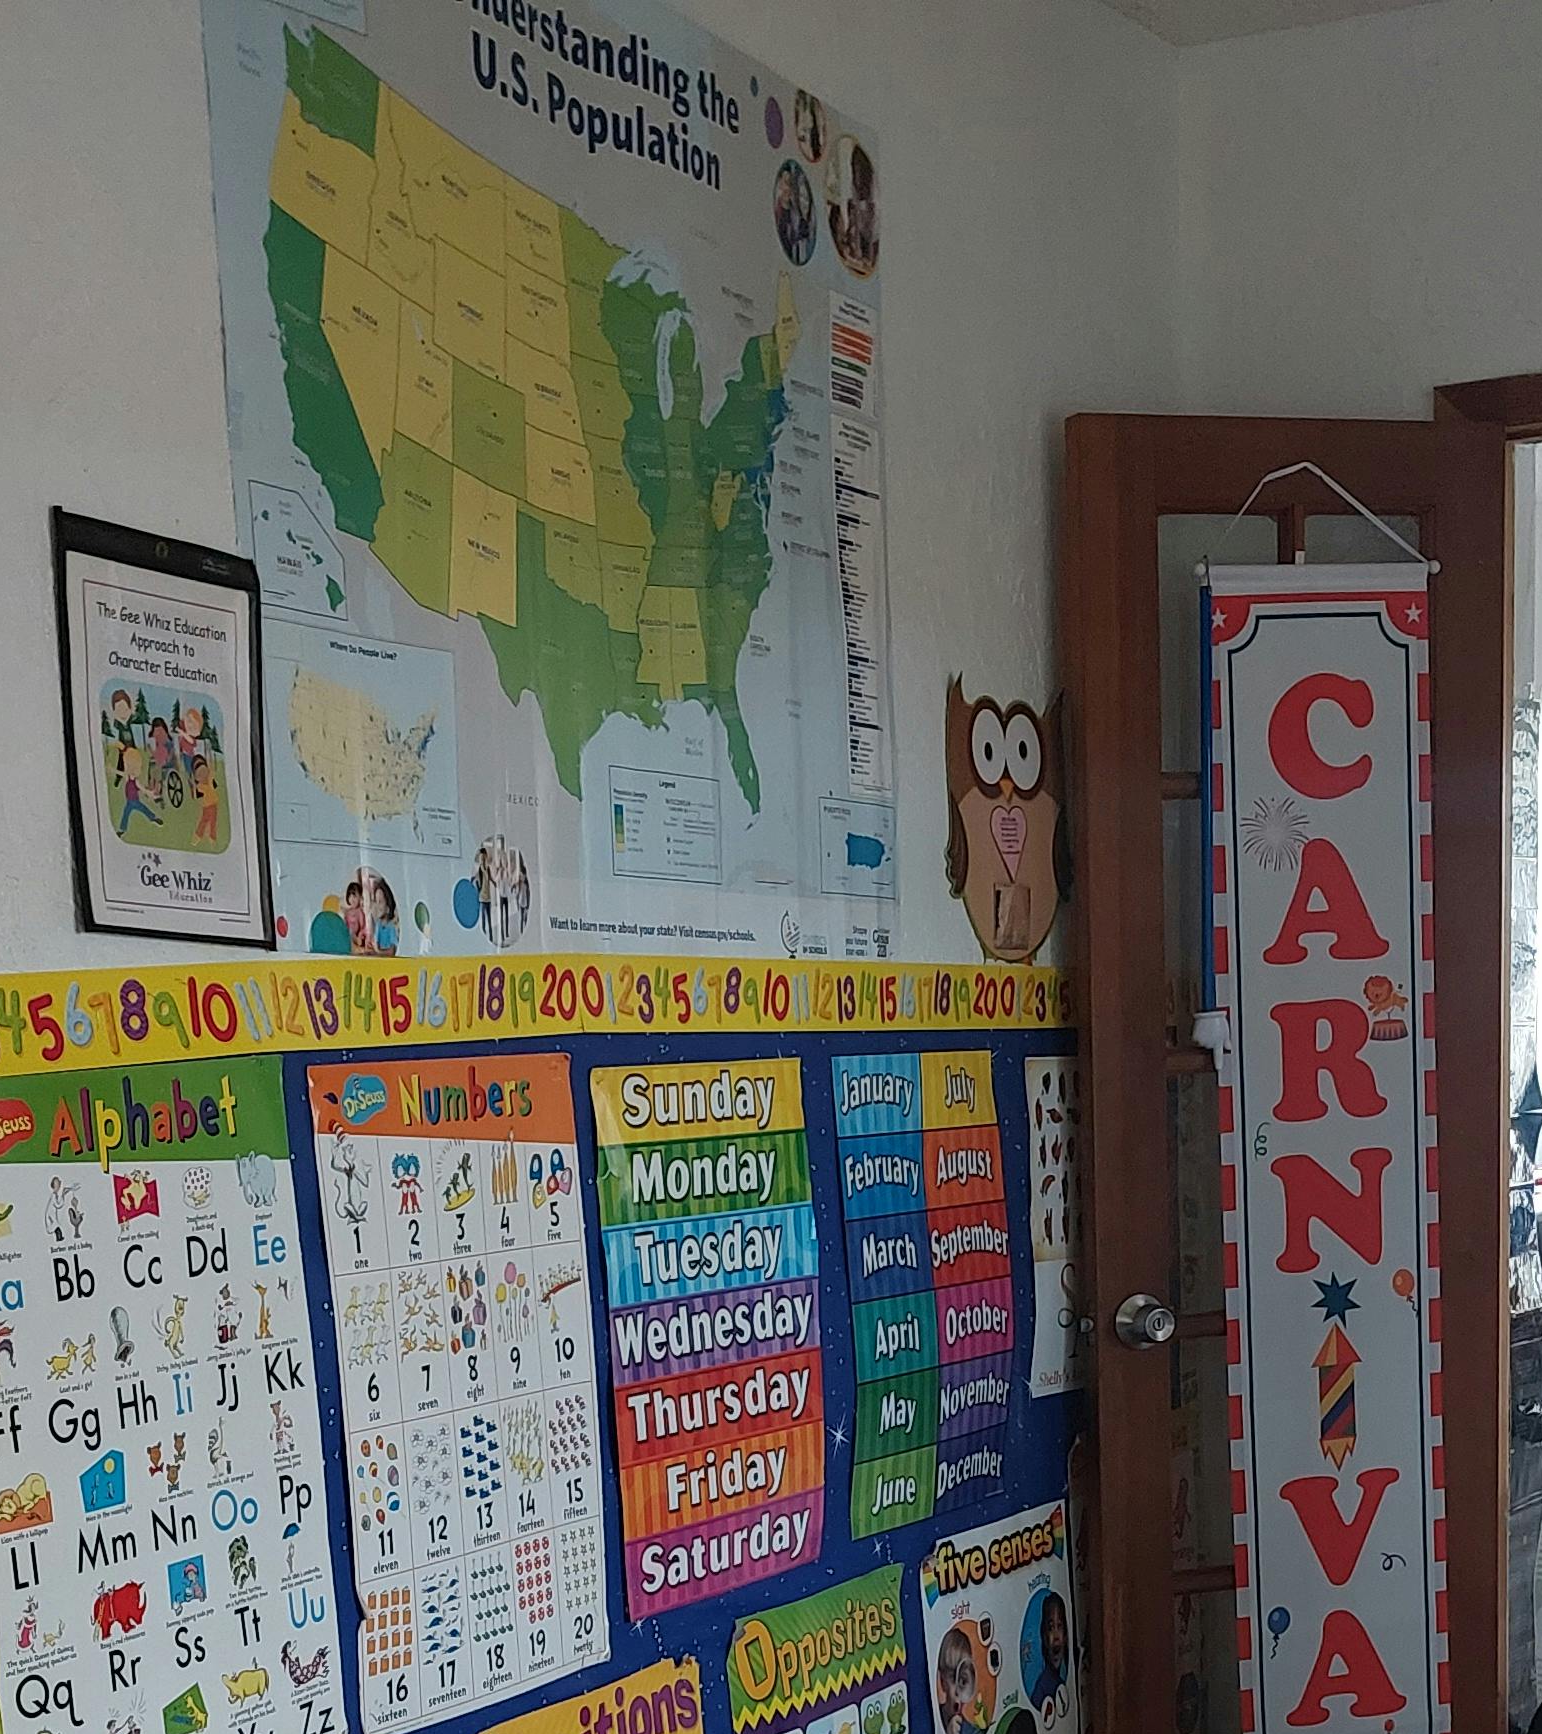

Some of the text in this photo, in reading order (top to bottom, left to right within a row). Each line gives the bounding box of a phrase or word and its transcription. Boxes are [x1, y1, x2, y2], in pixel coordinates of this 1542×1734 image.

[456, 0, 740, 134] derstanding the
[471, 30, 721, 190] U.S. Population
[97, 601, 226, 642] The Gee Whiz Education
[130, 632, 195, 657] Approach to
[109, 651, 218, 684] Character Education
[141, 865, 212, 891] Gee Whiz
[549, 916, 569, 931] Want
[570, 919, 578, 930] to
[579, 919, 597, 931] learn
[598, 923, 616, 933] more
[618, 922, 638, 935] about
[639, 924, 655, 938] your
[656, 926, 677, 937] state?
[678, 925, 694, 938] Visit
[28, 993, 65, 1063] 5
[64, 982, 93, 1047] 6
[397, 1066, 532, 1127] Numbers
[622, 1070, 775, 1128] Sunday
[841, 1066, 975, 1116] January July
[50, 1073, 238, 1174] Alphabet
[631, 1144, 777, 1205] Monday
[844, 1146, 993, 1198] February August
[52, 1254, 95, 1302] Bb
[123, 1245, 163, 1288] Cc
[185, 1228, 228, 1278] Dd
[252, 1224, 287, 1266] Ee
[634, 1220, 782, 1285] Tuesday
[862, 1219, 1008, 1278] March September
[614, 1288, 814, 1371] Wednesday
[875, 1299, 1008, 1361] April October
[48, 1398, 102, 1451] Gg
[116, 1380, 159, 1429] Hh
[217, 1363, 238, 1411] Jj
[264, 1349, 305, 1394] Kk
[627, 1366, 811, 1443] Thursday
[879, 1371, 1010, 1434] May November
[666, 1446, 787, 1512] Friday
[871, 1445, 1003, 1516] June December
[1, 1537, 13, 1545] Lion
[13, 1534, 24, 1542] with
[30, 1528, 48, 1538] lollipop
[373, 1530, 501, 1575] eleven twelve thirteen
[640, 1508, 811, 1594] Saturday
[934, 1519, 1054, 1597] five senses
[951, 1600, 971, 1621] sight
[7, 1660, 18, 1668] The
[734, 1598, 896, 1701] Opposites
[377, 1671, 513, 1725] sixteen seventeen eighteen
